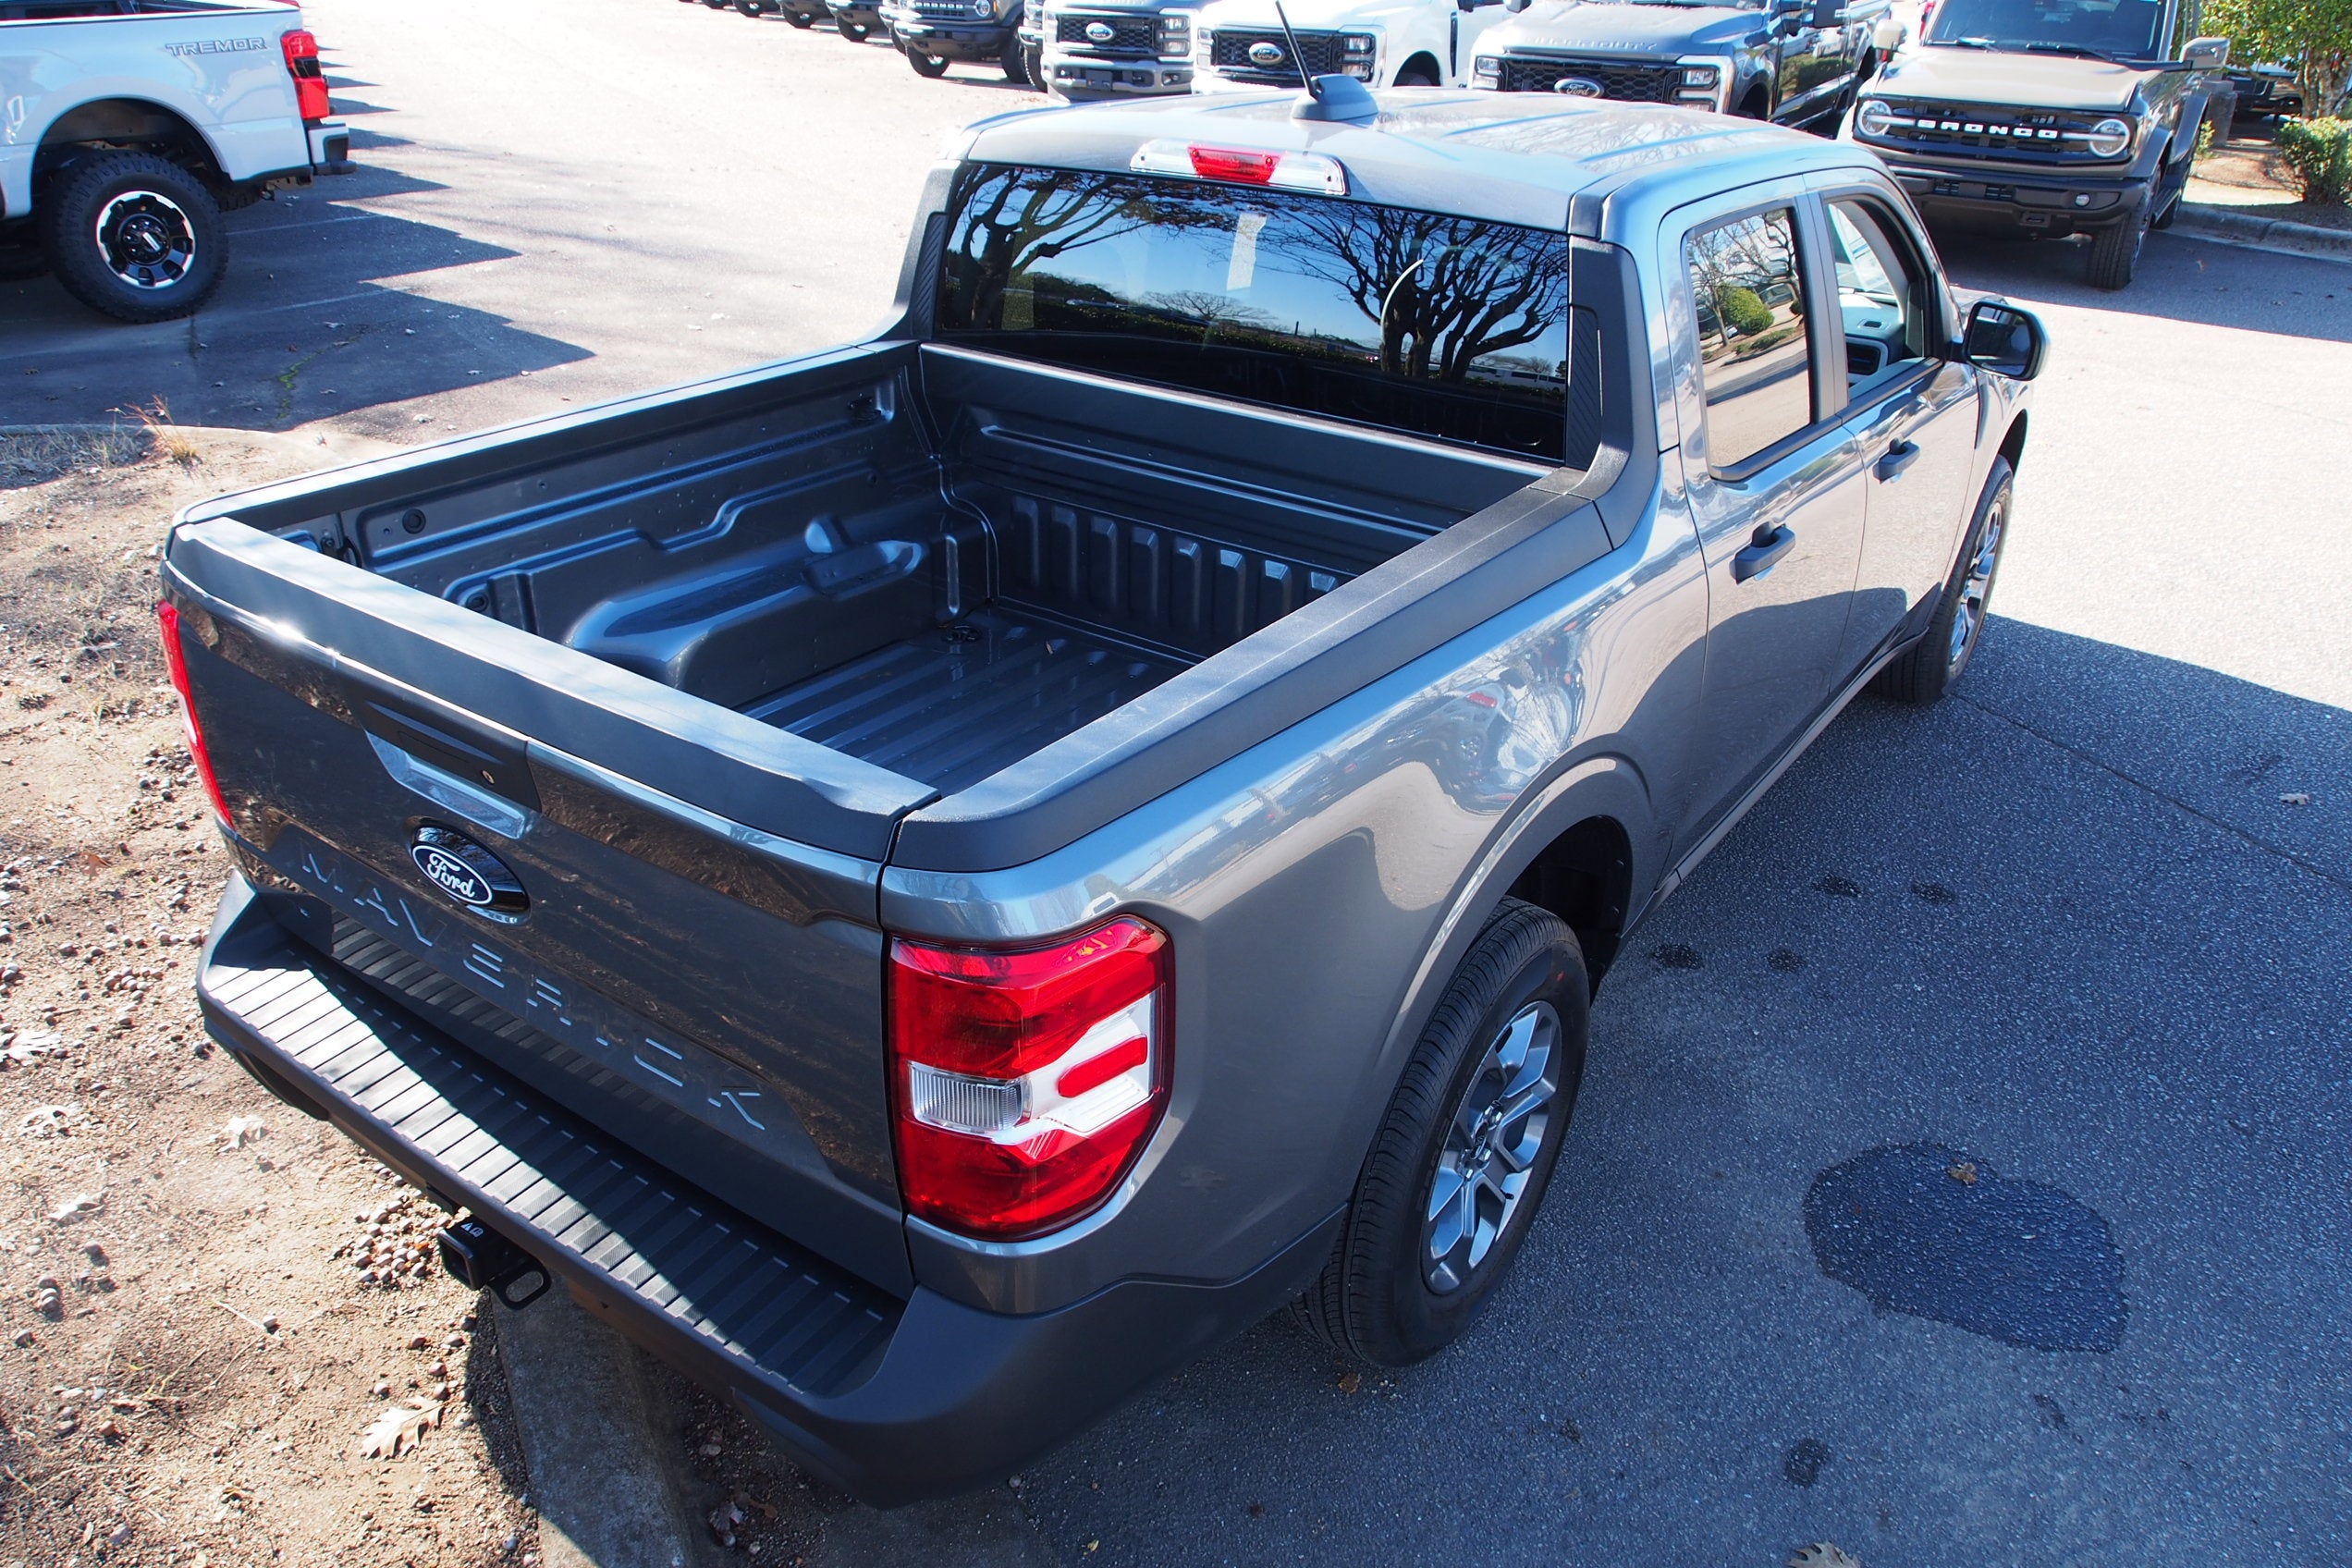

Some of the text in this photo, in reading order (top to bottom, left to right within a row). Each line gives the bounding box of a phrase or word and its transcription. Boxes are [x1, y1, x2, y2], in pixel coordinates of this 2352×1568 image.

[165, 37, 267, 56] TREMOR
[1917, 118, 2059, 139] BRONCO
[424, 850, 477, 900] Ford
[299, 840, 766, 1131] MAVERICK
